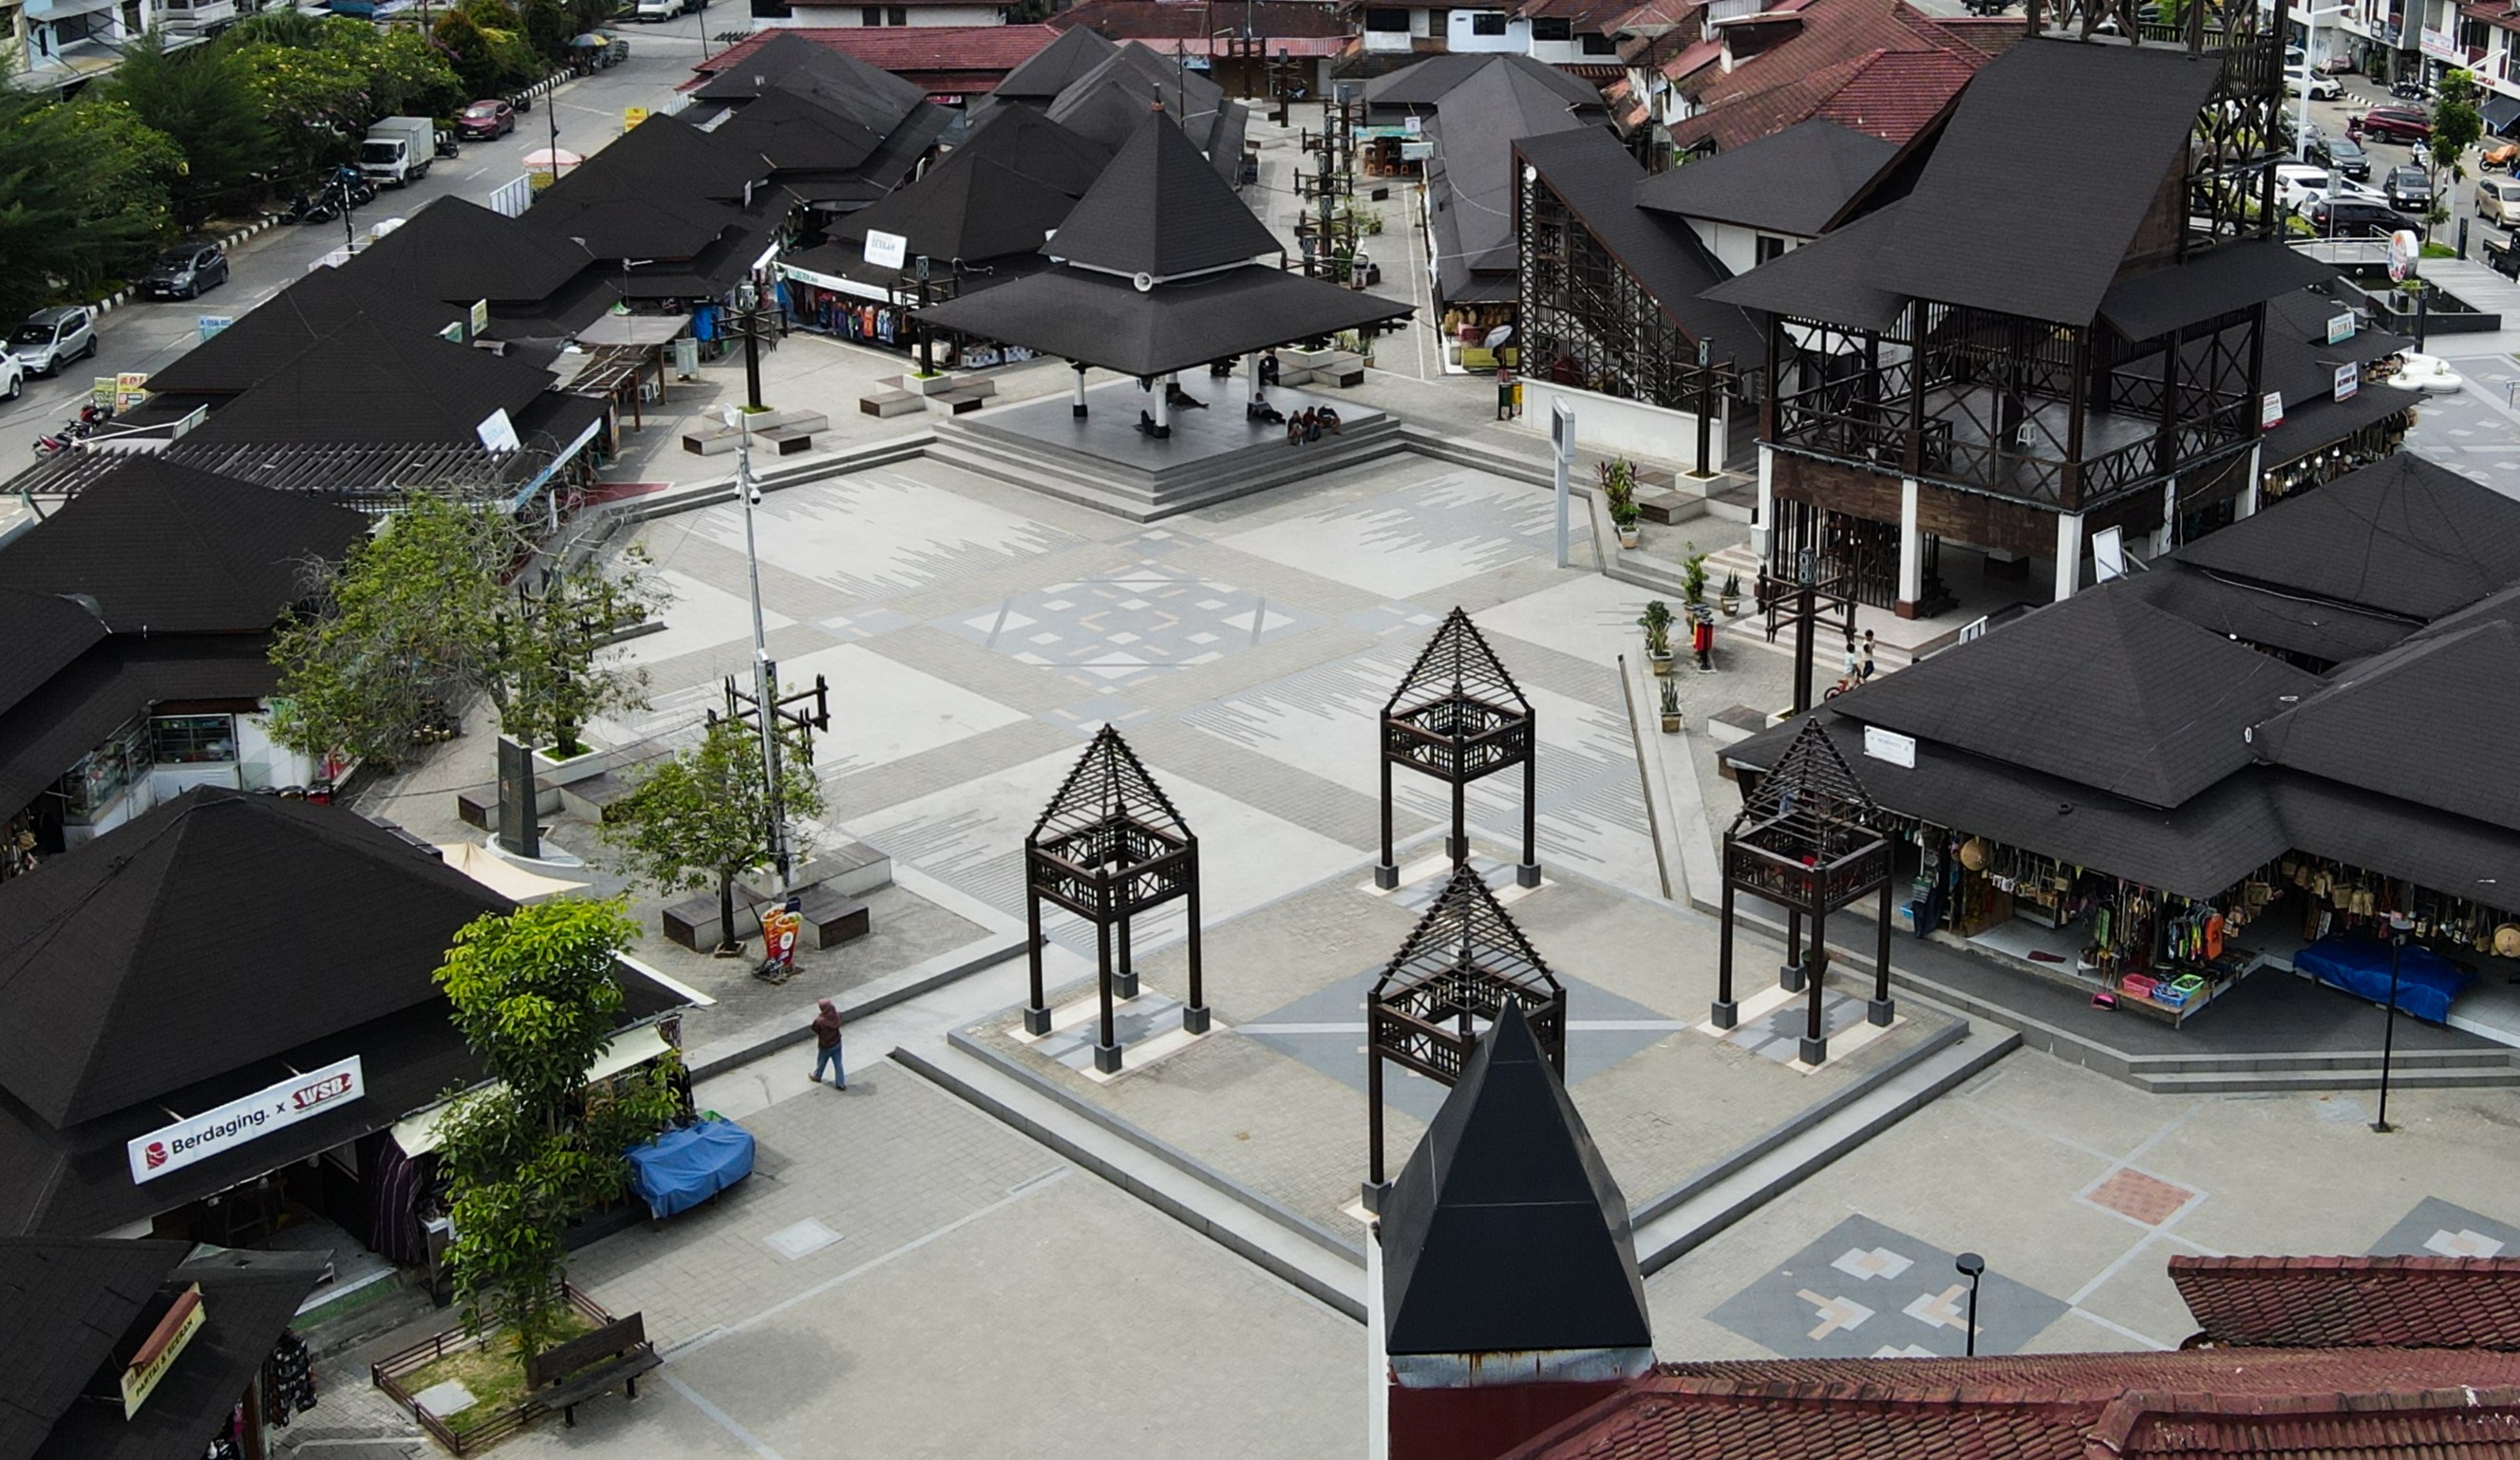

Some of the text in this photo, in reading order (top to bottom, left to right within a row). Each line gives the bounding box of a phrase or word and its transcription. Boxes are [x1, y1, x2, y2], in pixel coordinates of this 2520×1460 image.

[172, 1110, 270, 1155] Berdaging.
[298, 1077, 344, 1105] WSB
[136, 1364, 160, 1397] PARTAI
[160, 1355, 167, 1364] &
